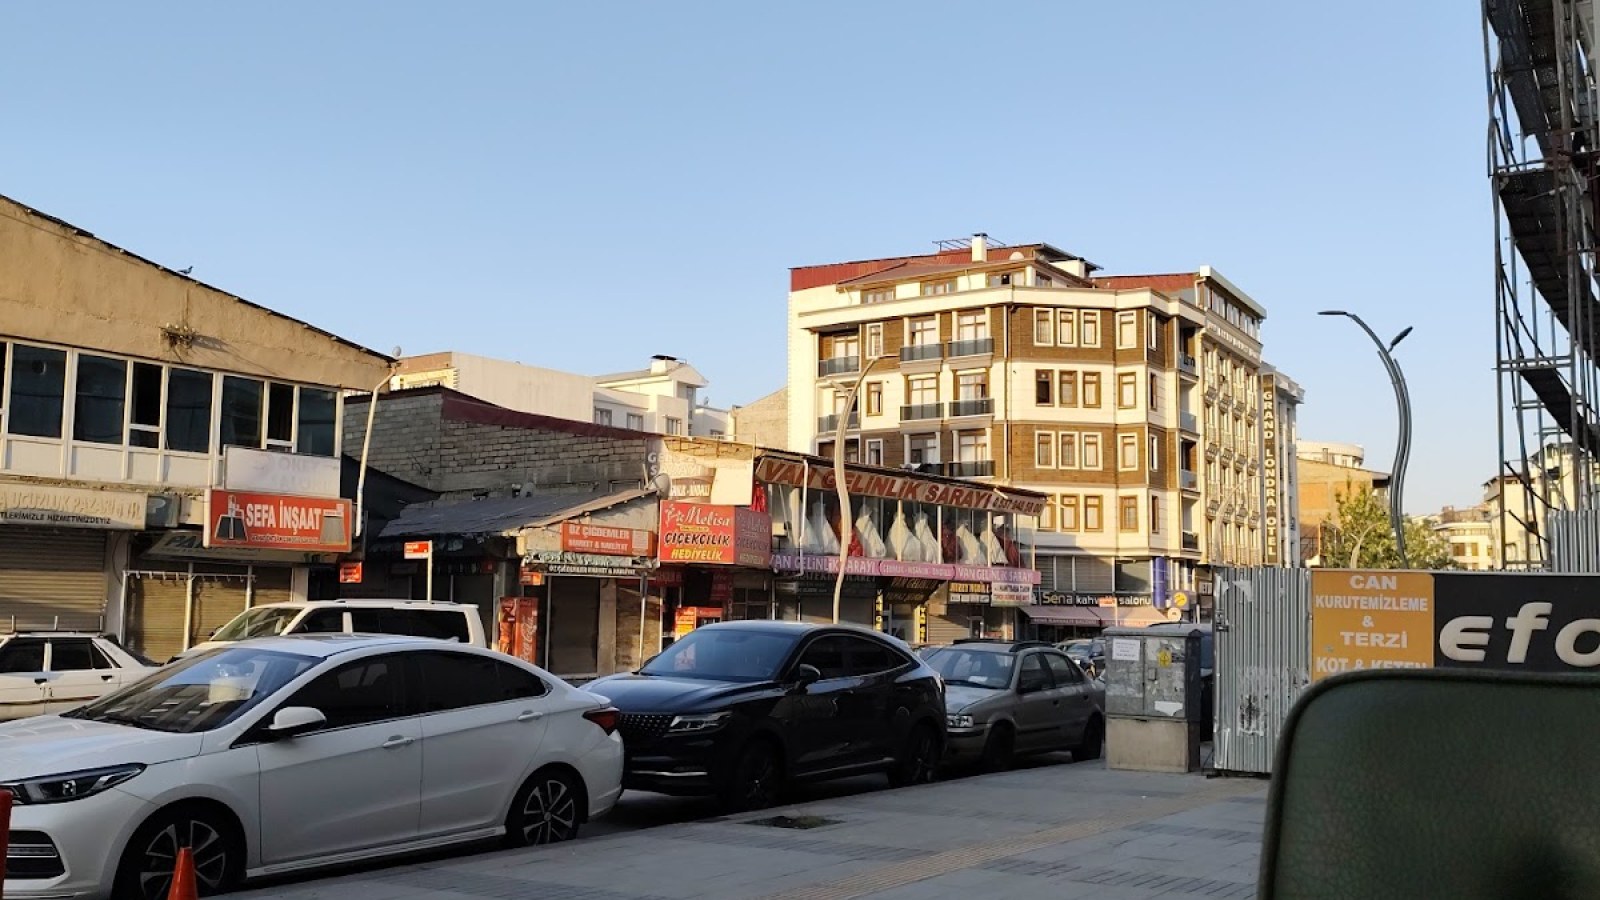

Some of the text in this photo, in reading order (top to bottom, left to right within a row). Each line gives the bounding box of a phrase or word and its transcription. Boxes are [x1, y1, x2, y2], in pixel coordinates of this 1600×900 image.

[1263, 391, 1277, 556] GRAND LONDRA OTEL
[764, 460, 817, 487] VAN
[821, 469, 922, 500] GELİNLİK
[924, 485, 992, 509] SARAYI
[246, 499, 322, 535] SEFA İNŞAAT
[684, 505, 730, 526] Melisa
[671, 547, 723, 561] HEDİYELİK
[795, 556, 839, 573] GELİNLİK
[845, 559, 876, 574] ARAYI
[958, 567, 976, 579] VAN
[1350, 575, 1397, 590] CAN
[1042, 592, 1073, 605] Sena
[1119, 595, 1151, 606] salonu
[1315, 593, 1428, 612] KURUTEMİZLEME
[1362, 616, 1374, 628] &
[1340, 631, 1408, 649] TERZİ
[1316, 656, 1349, 674] KOT
